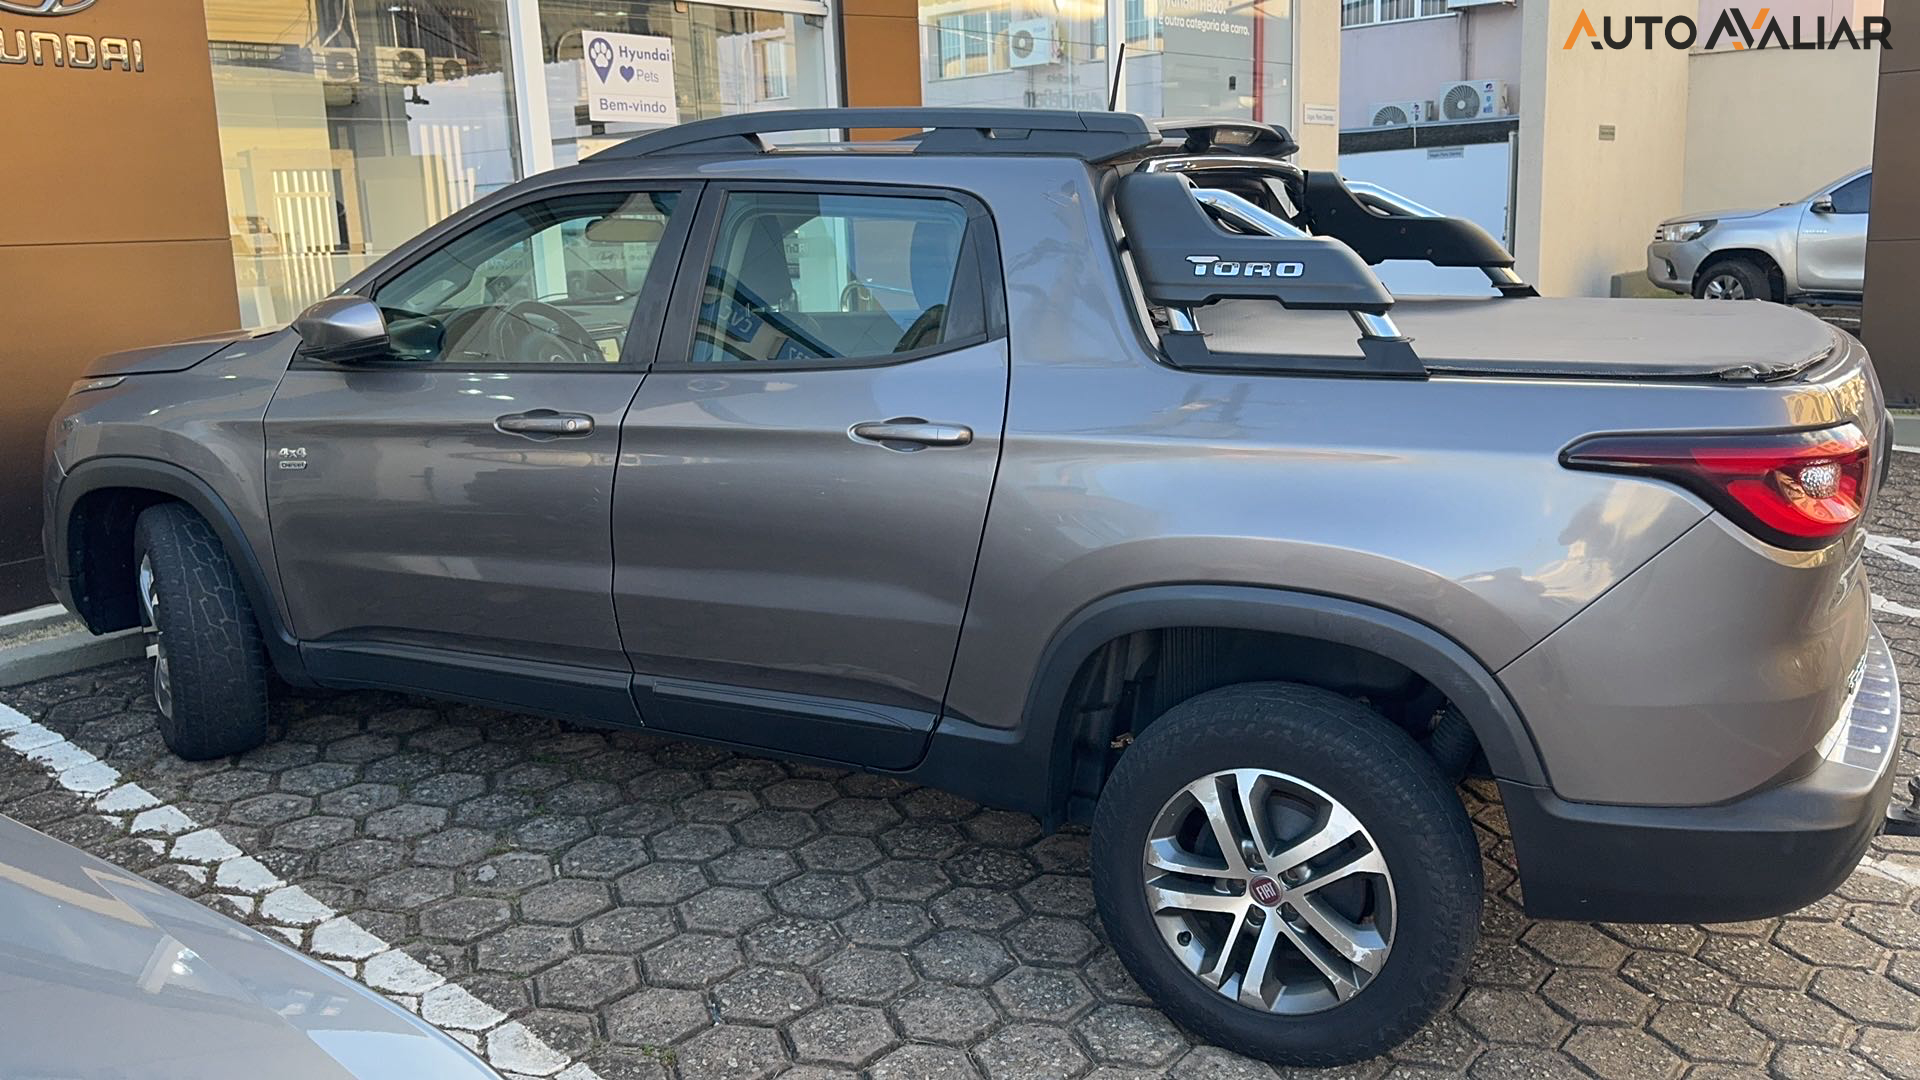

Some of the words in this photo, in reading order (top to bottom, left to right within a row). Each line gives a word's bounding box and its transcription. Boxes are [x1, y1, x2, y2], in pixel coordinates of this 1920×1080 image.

[1165, 15, 1185, 28] outra
[1186, 17, 1220, 32] categoria
[1220, 20, 1230, 33] de
[619, 45, 670, 62] Hyundai
[636, 68, 660, 83] Pets
[599, 98, 667, 114] Bem-vindo
[279, 447, 307, 458] 4x4
[1256, 881, 1276, 901] FIAT
